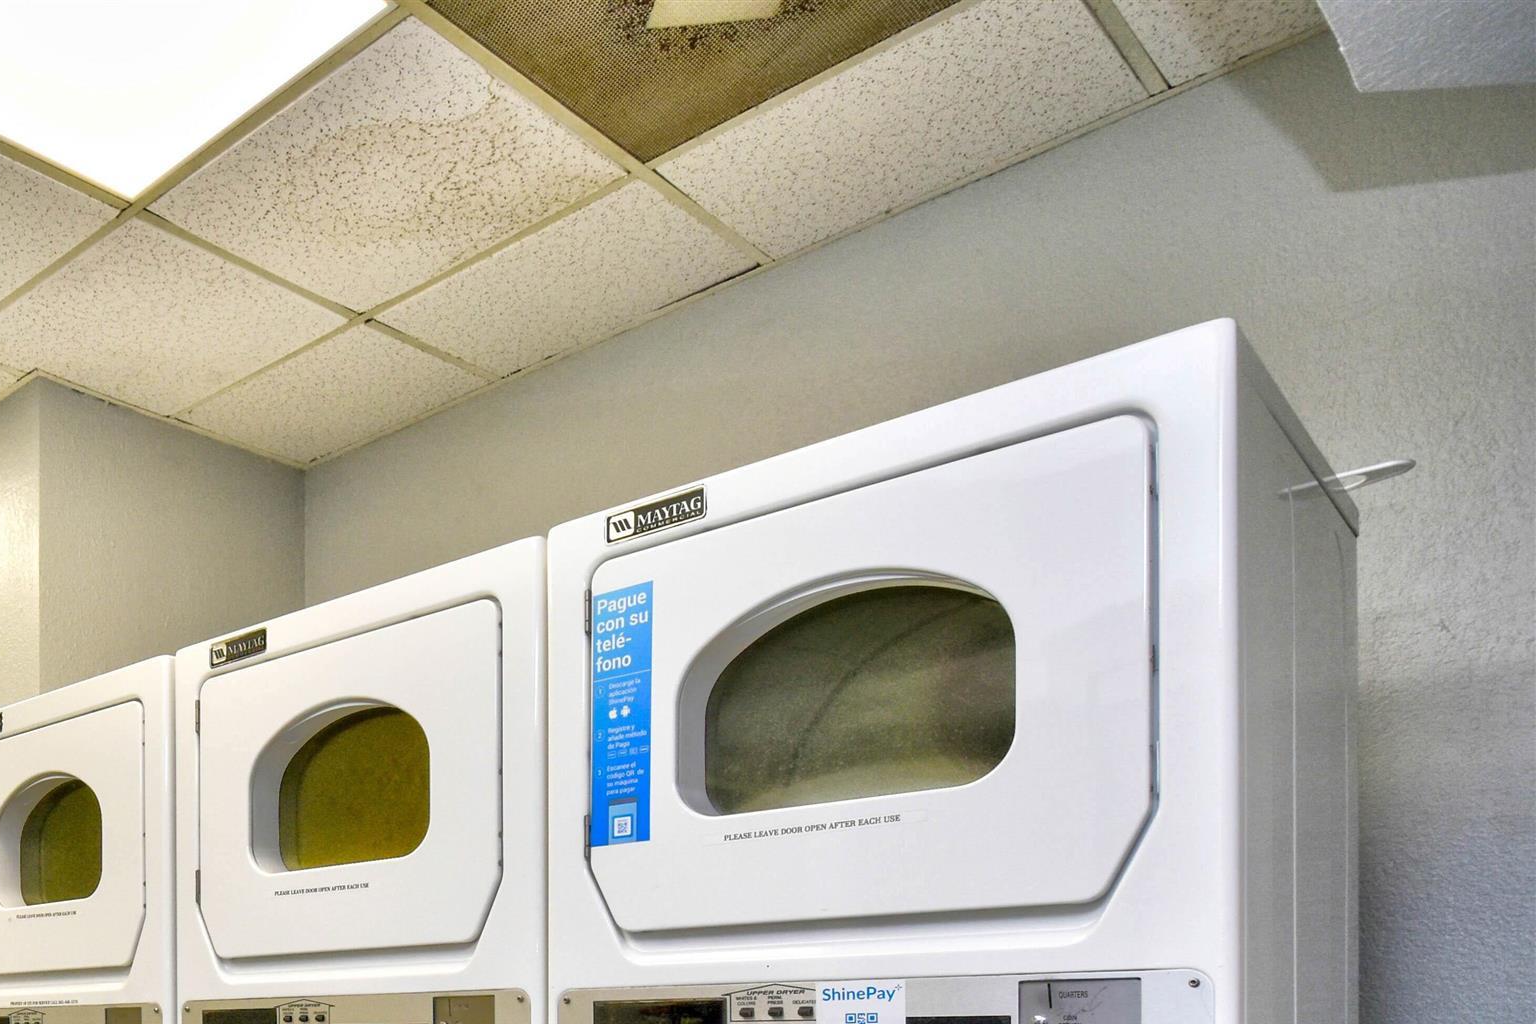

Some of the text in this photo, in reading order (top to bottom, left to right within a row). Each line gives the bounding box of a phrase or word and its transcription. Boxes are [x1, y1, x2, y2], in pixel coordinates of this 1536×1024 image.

[635, 511, 701, 533] COMMERCIAL
[637, 496, 702, 527] MAYTAG
[597, 592, 647, 615] Pague
[596, 610, 649, 634] con su
[227, 635, 265, 654] MAYTAG
[596, 632, 632, 653] telé-
[596, 655, 632, 673] fono
[724, 814, 901, 841] PLEASE LEAVE DOOR OPEN AFTER EACH USE
[822, 987, 895, 1002] ShinePay
